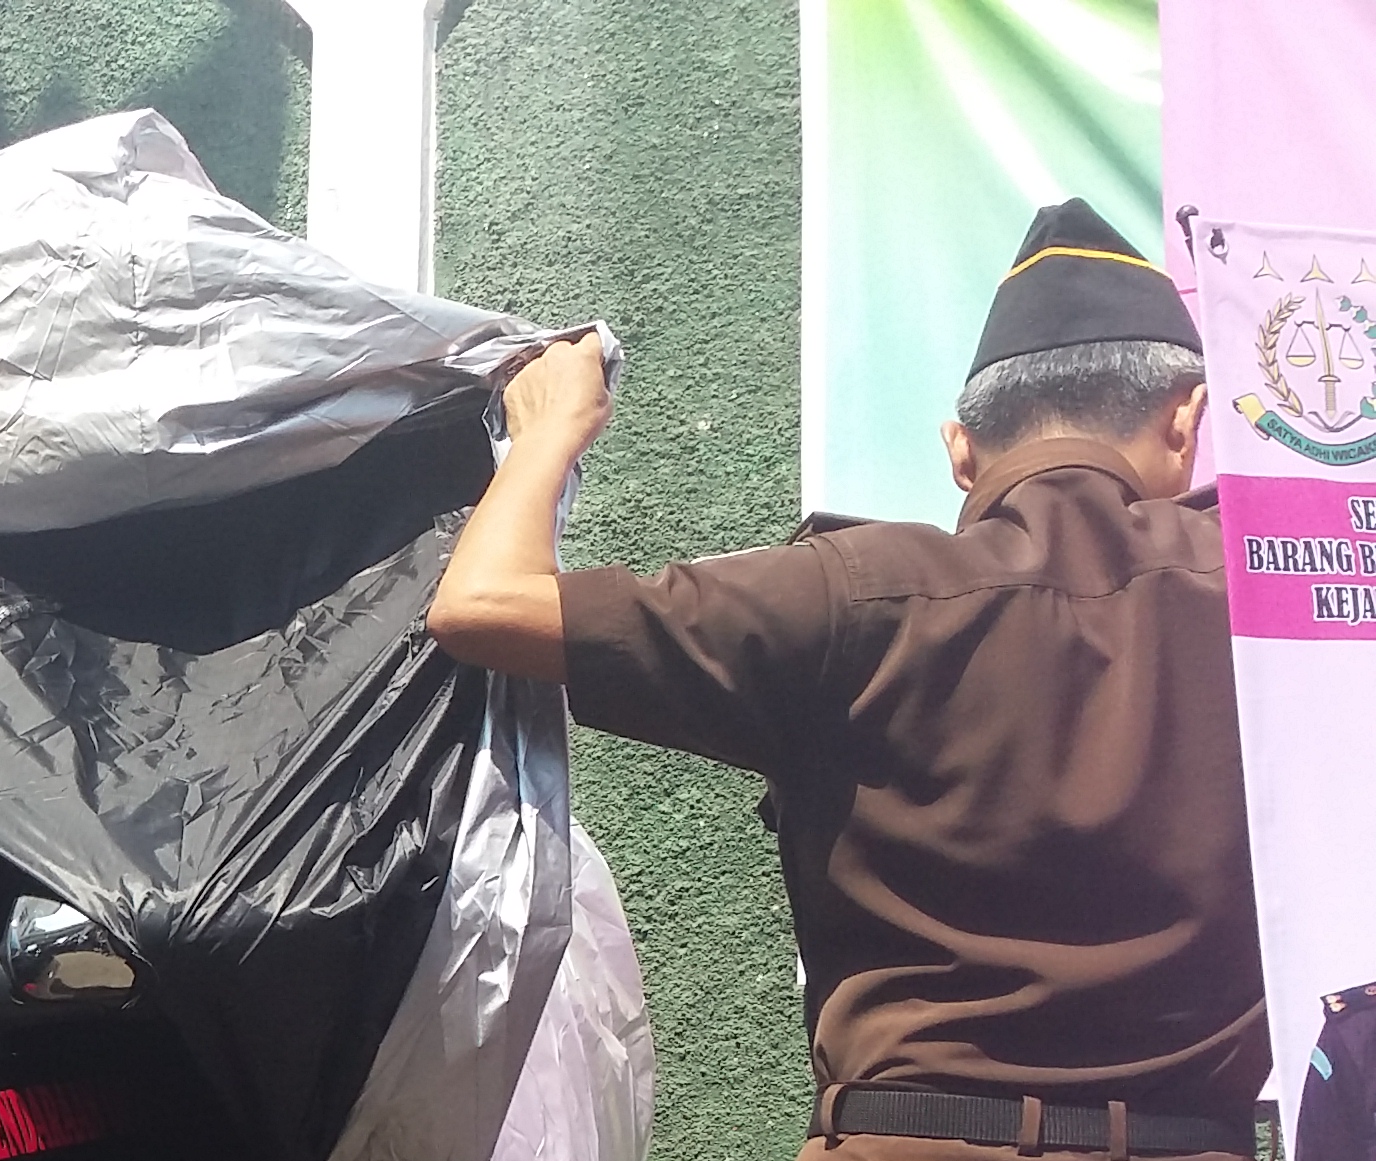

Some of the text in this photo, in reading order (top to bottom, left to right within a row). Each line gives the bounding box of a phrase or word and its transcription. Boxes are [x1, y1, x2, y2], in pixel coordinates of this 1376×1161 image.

[1267, 418, 1303, 449] SATYA
[1304, 444, 1330, 460] ADHI
[1245, 537, 1376, 575] BARANG B
